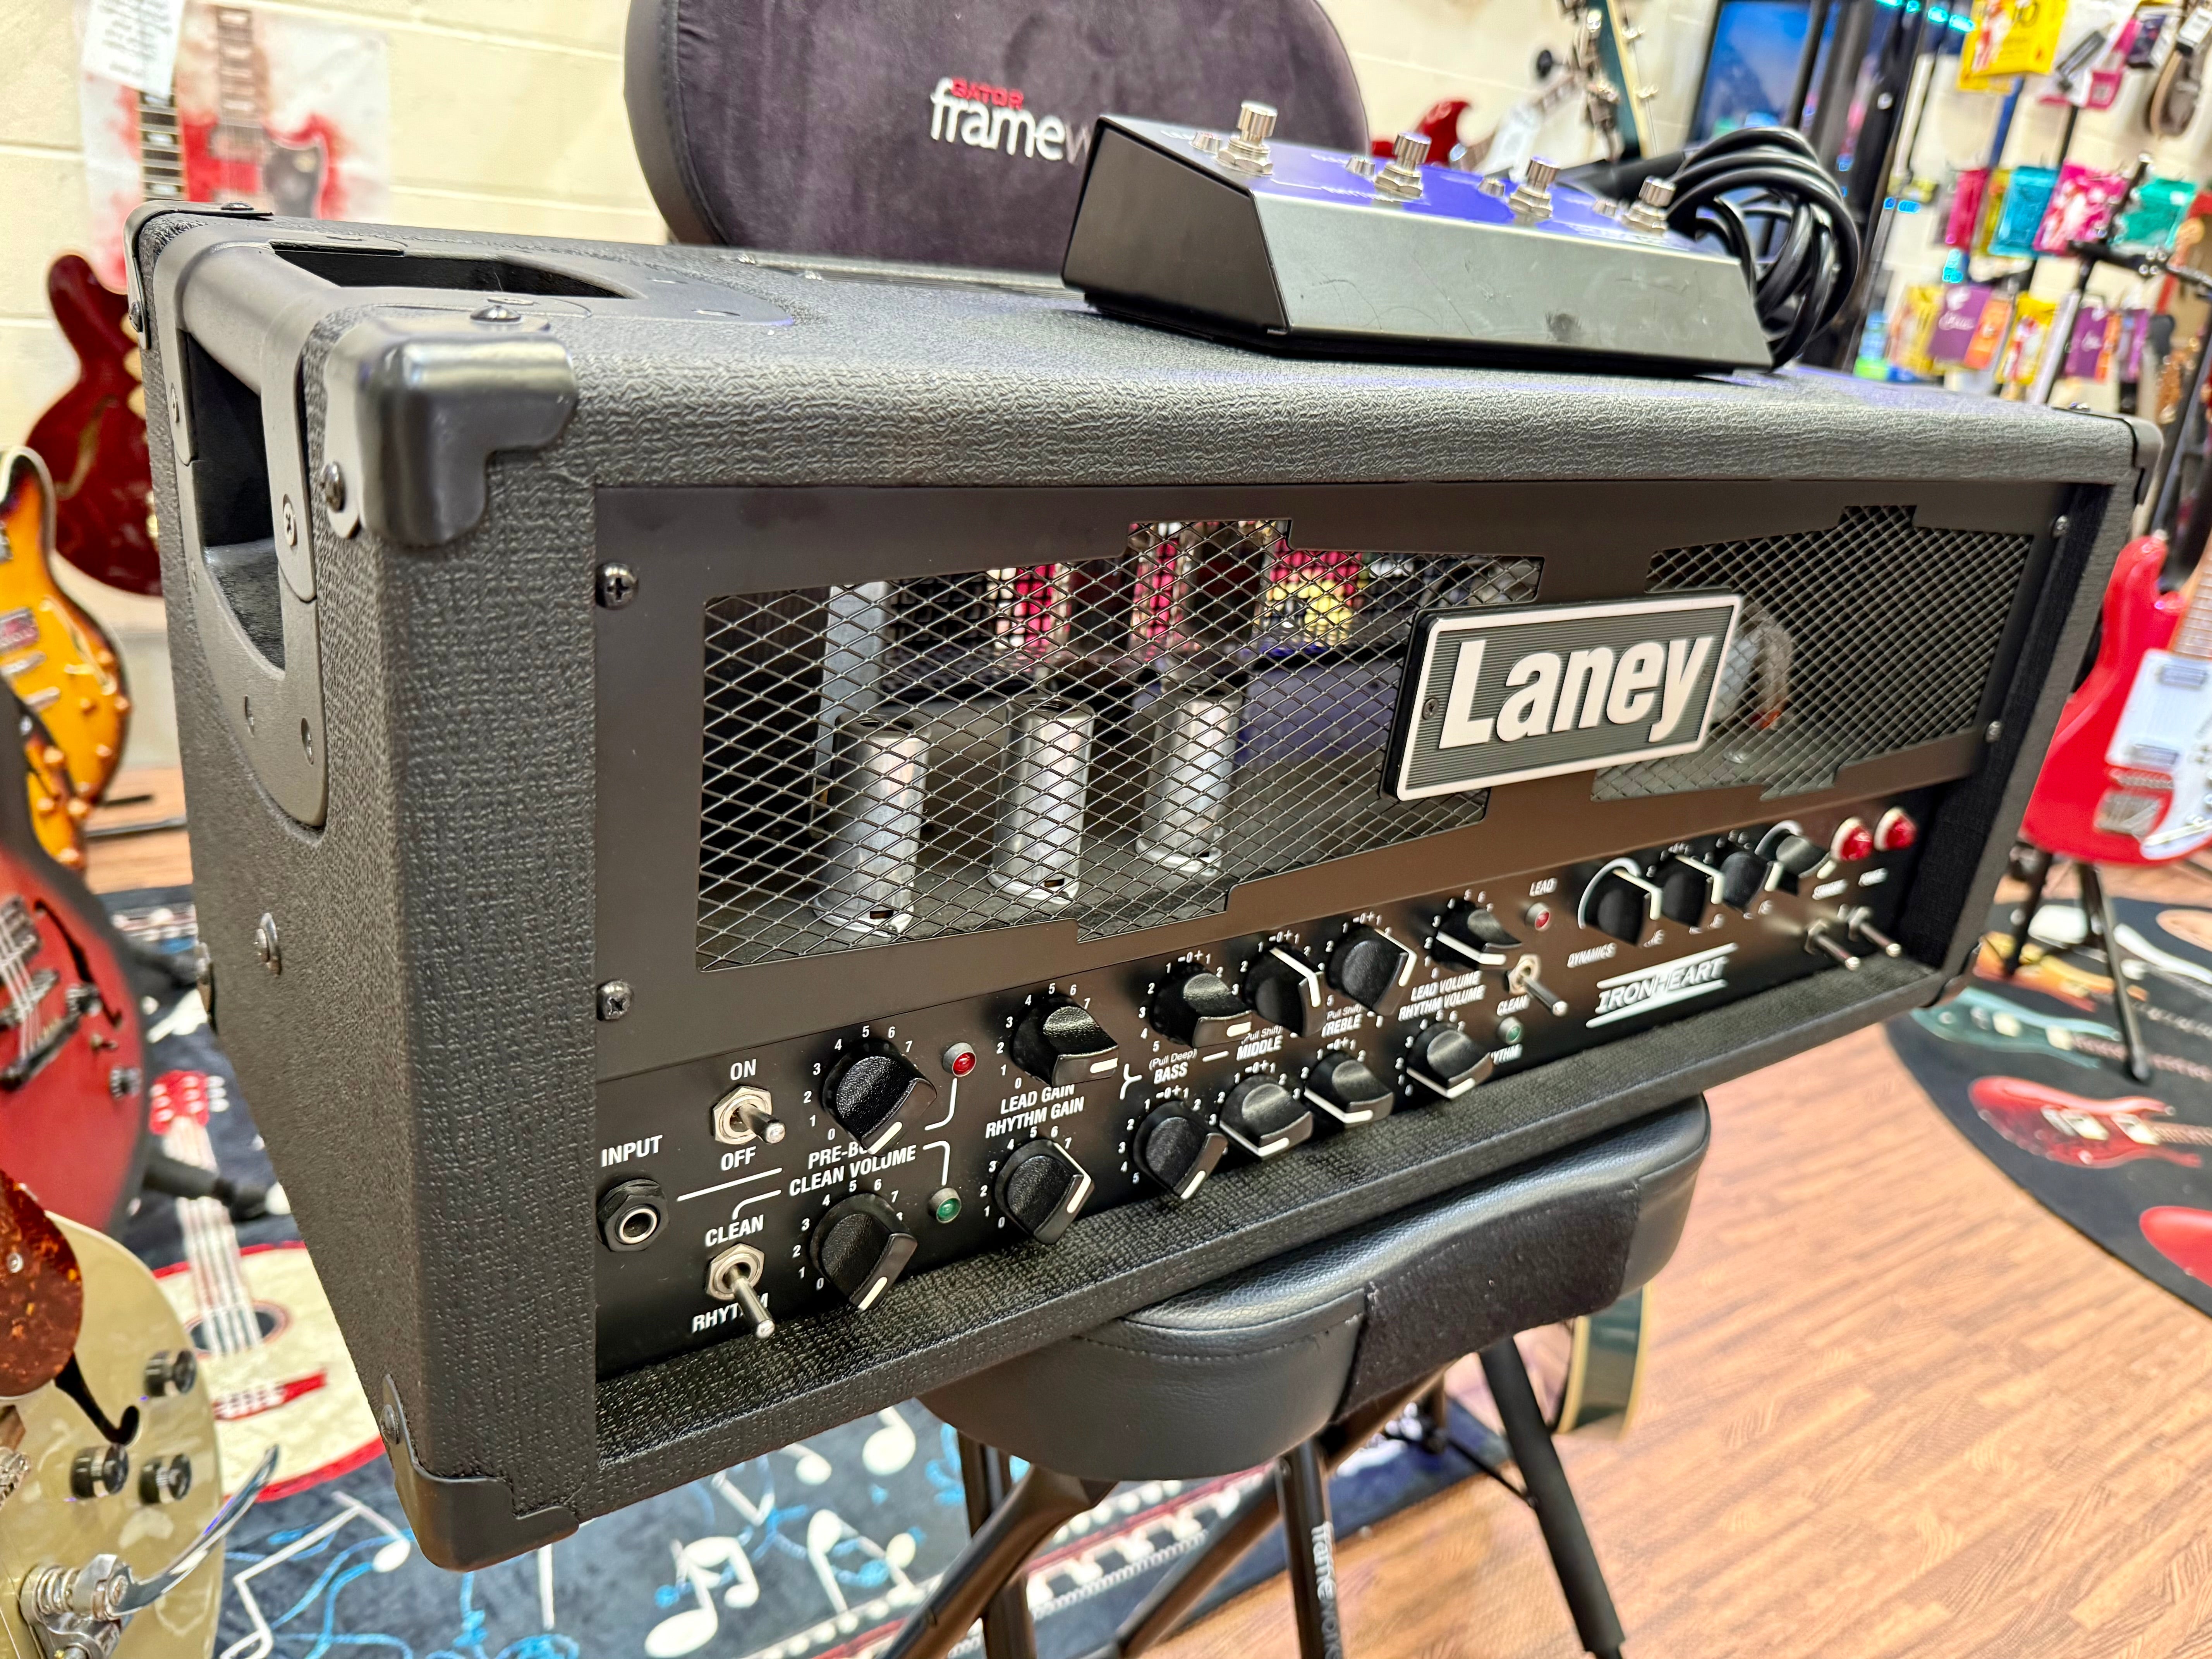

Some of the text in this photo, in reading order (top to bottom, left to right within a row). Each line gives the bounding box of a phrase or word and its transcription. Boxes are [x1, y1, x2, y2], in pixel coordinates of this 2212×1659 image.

[930, 77, 1091, 165] framew
[1439, 636, 1713, 749] Laney
[1529, 878, 1558, 897] LEAD
[1205, 953, 1211, 964] 1
[1567, 942, 1617, 968] DYNAMICS
[1166, 962, 1171, 974] 1
[1216, 966, 1224, 978] 2
[1240, 960, 1249, 972] 2
[1147, 982, 1155, 994] 2
[1231, 984, 1239, 996] 3
[1411, 970, 1483, 1002] LEAD VOLUME
[1595, 956, 1729, 1014] IRONHEART
[1139, 1006, 1146, 1018] 3
[1398, 984, 1486, 1022] RHYTHM VOLUME
[1496, 994, 1530, 1017] CLEAN
[996, 983, 1091, 1089] 0 1 2 3 4 5 6 7
[1140, 1028, 1148, 1039] 4
[1153, 1040, 1160, 1052] 5
[1236, 1035, 1283, 1061] MIDDLE
[1491, 1044, 1523, 1065] YTHM
[730, 1058, 757, 1080] ON
[1149, 1048, 1198, 1071] (Pull Deep)
[1300, 1066, 1310, 1079] 2
[1317, 1048, 1324, 1060] 1
[1357, 1050, 1366, 1062] 2
[1154, 1061, 1188, 1084] BASS
[804, 1025, 913, 1140] 0 1 2 3 4 5 6 7
[1217, 1091, 1226, 1104] 2
[1234, 1072, 1240, 1084] 1
[1270, 1062, 1276, 1074] 1
[1278, 1073, 1287, 1085] 2
[1292, 1088, 1301, 1100] 3
[1000, 1084, 1075, 1114] LEAD GAIN
[1183, 1087, 1189, 1099] 1
[1144, 1098, 1151, 1111] 1
[1192, 1099, 1201, 1111] 2
[986, 1096, 1084, 1139] RHYTHM GAIN
[1127, 1118, 1135, 1131] 2
[1209, 1113, 1217, 1126] 3
[601, 1135, 663, 1168] INPUT
[1118, 1141, 1126, 1154] 3
[721, 1146, 756, 1171] OFF
[1120, 1161, 1128, 1173] 4
[789, 1144, 917, 1196] CLEAN VOLUME
[979, 1126, 1072, 1228] 0 1 2 3 4 5 6 7
[849, 1180, 857, 1192] 5
[874, 1179, 882, 1191] 6
[822, 1194, 830, 1206] 4
[891, 1190, 899, 1203] 7
[705, 1214, 764, 1248] CLEAN
[801, 1218, 810, 1231] 3
[792, 1245, 801, 1258] 2
[799, 1266, 805, 1279] 1
[816, 1278, 824, 1291] 0
[691, 1292, 768, 1334] RHYTM
